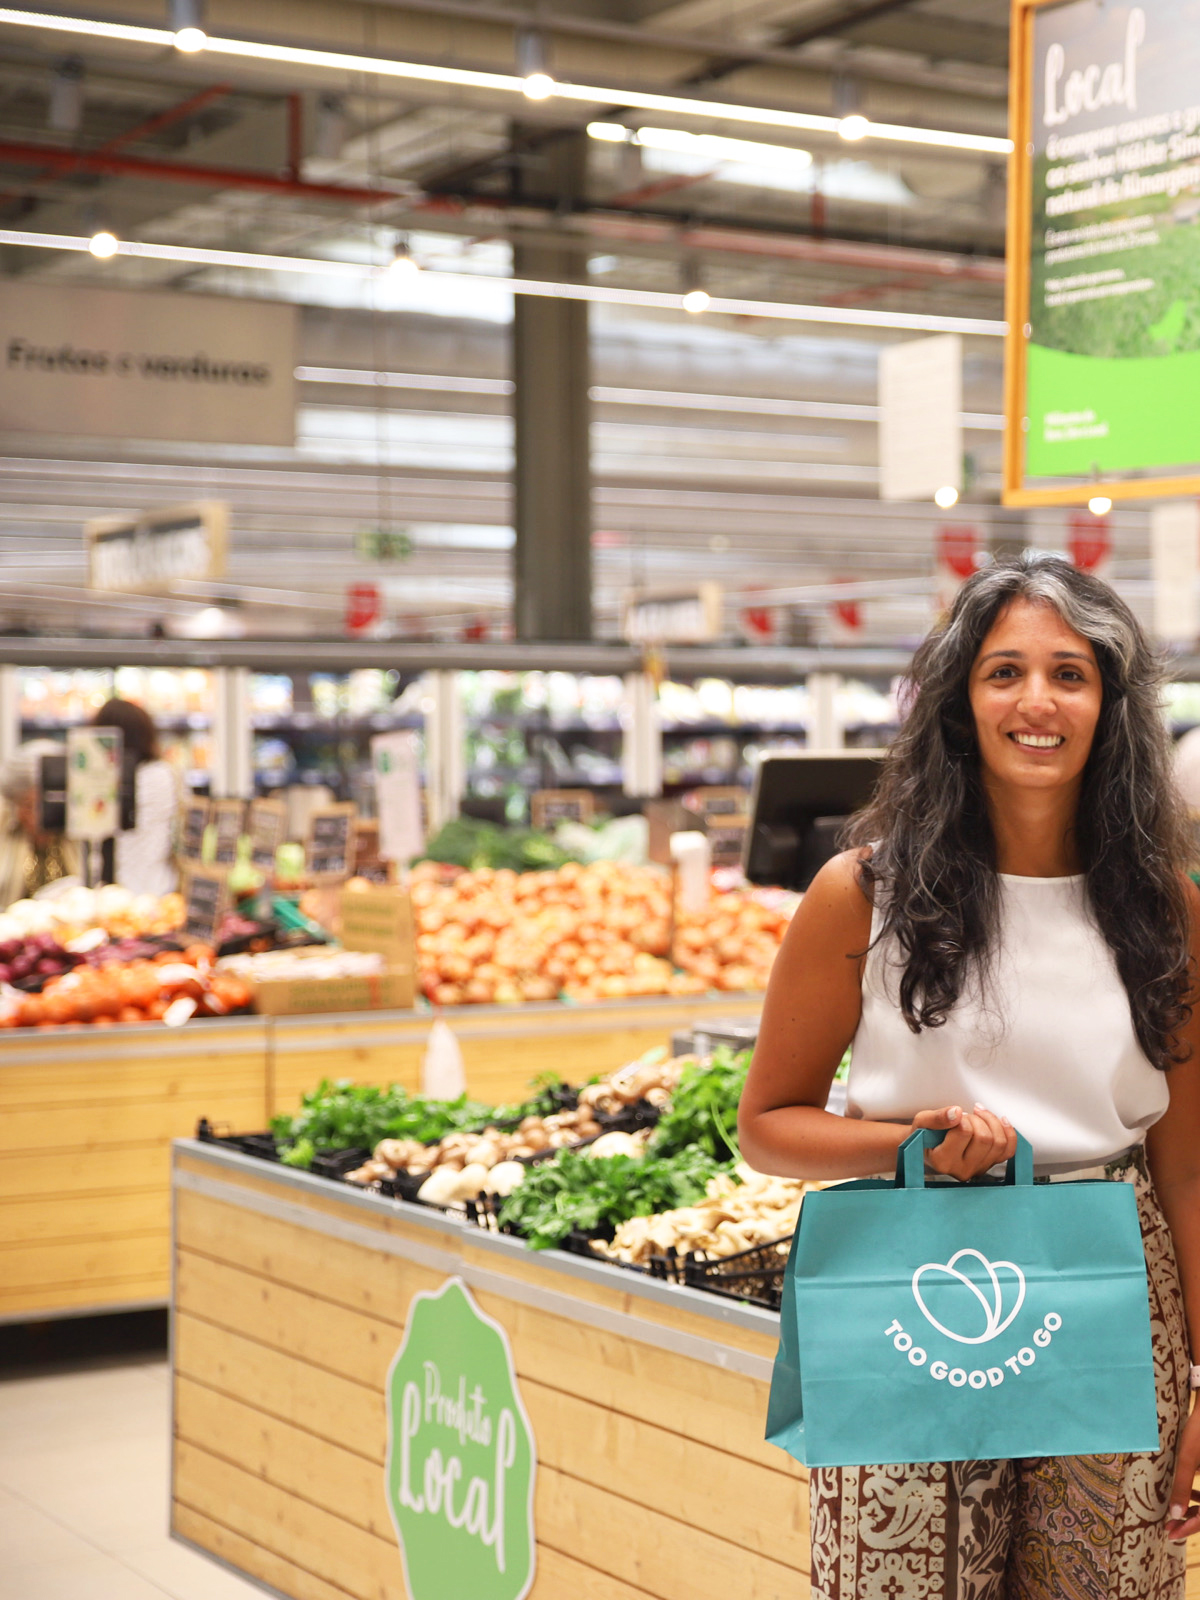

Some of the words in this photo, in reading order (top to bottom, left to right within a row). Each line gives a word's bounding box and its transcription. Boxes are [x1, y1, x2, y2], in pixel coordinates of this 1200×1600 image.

[1043, 8, 1145, 127] Local
[8, 338, 108, 376] Frutas
[141, 352, 270, 387] verduras
[884, 1318, 928, 1366] TOO
[930, 1361, 1005, 1389] GOOD
[1004, 1347, 1036, 1375] TO
[1033, 1312, 1062, 1347] GO
[423, 1361, 492, 1446] Produto
[398, 1381, 516, 1573] Local
